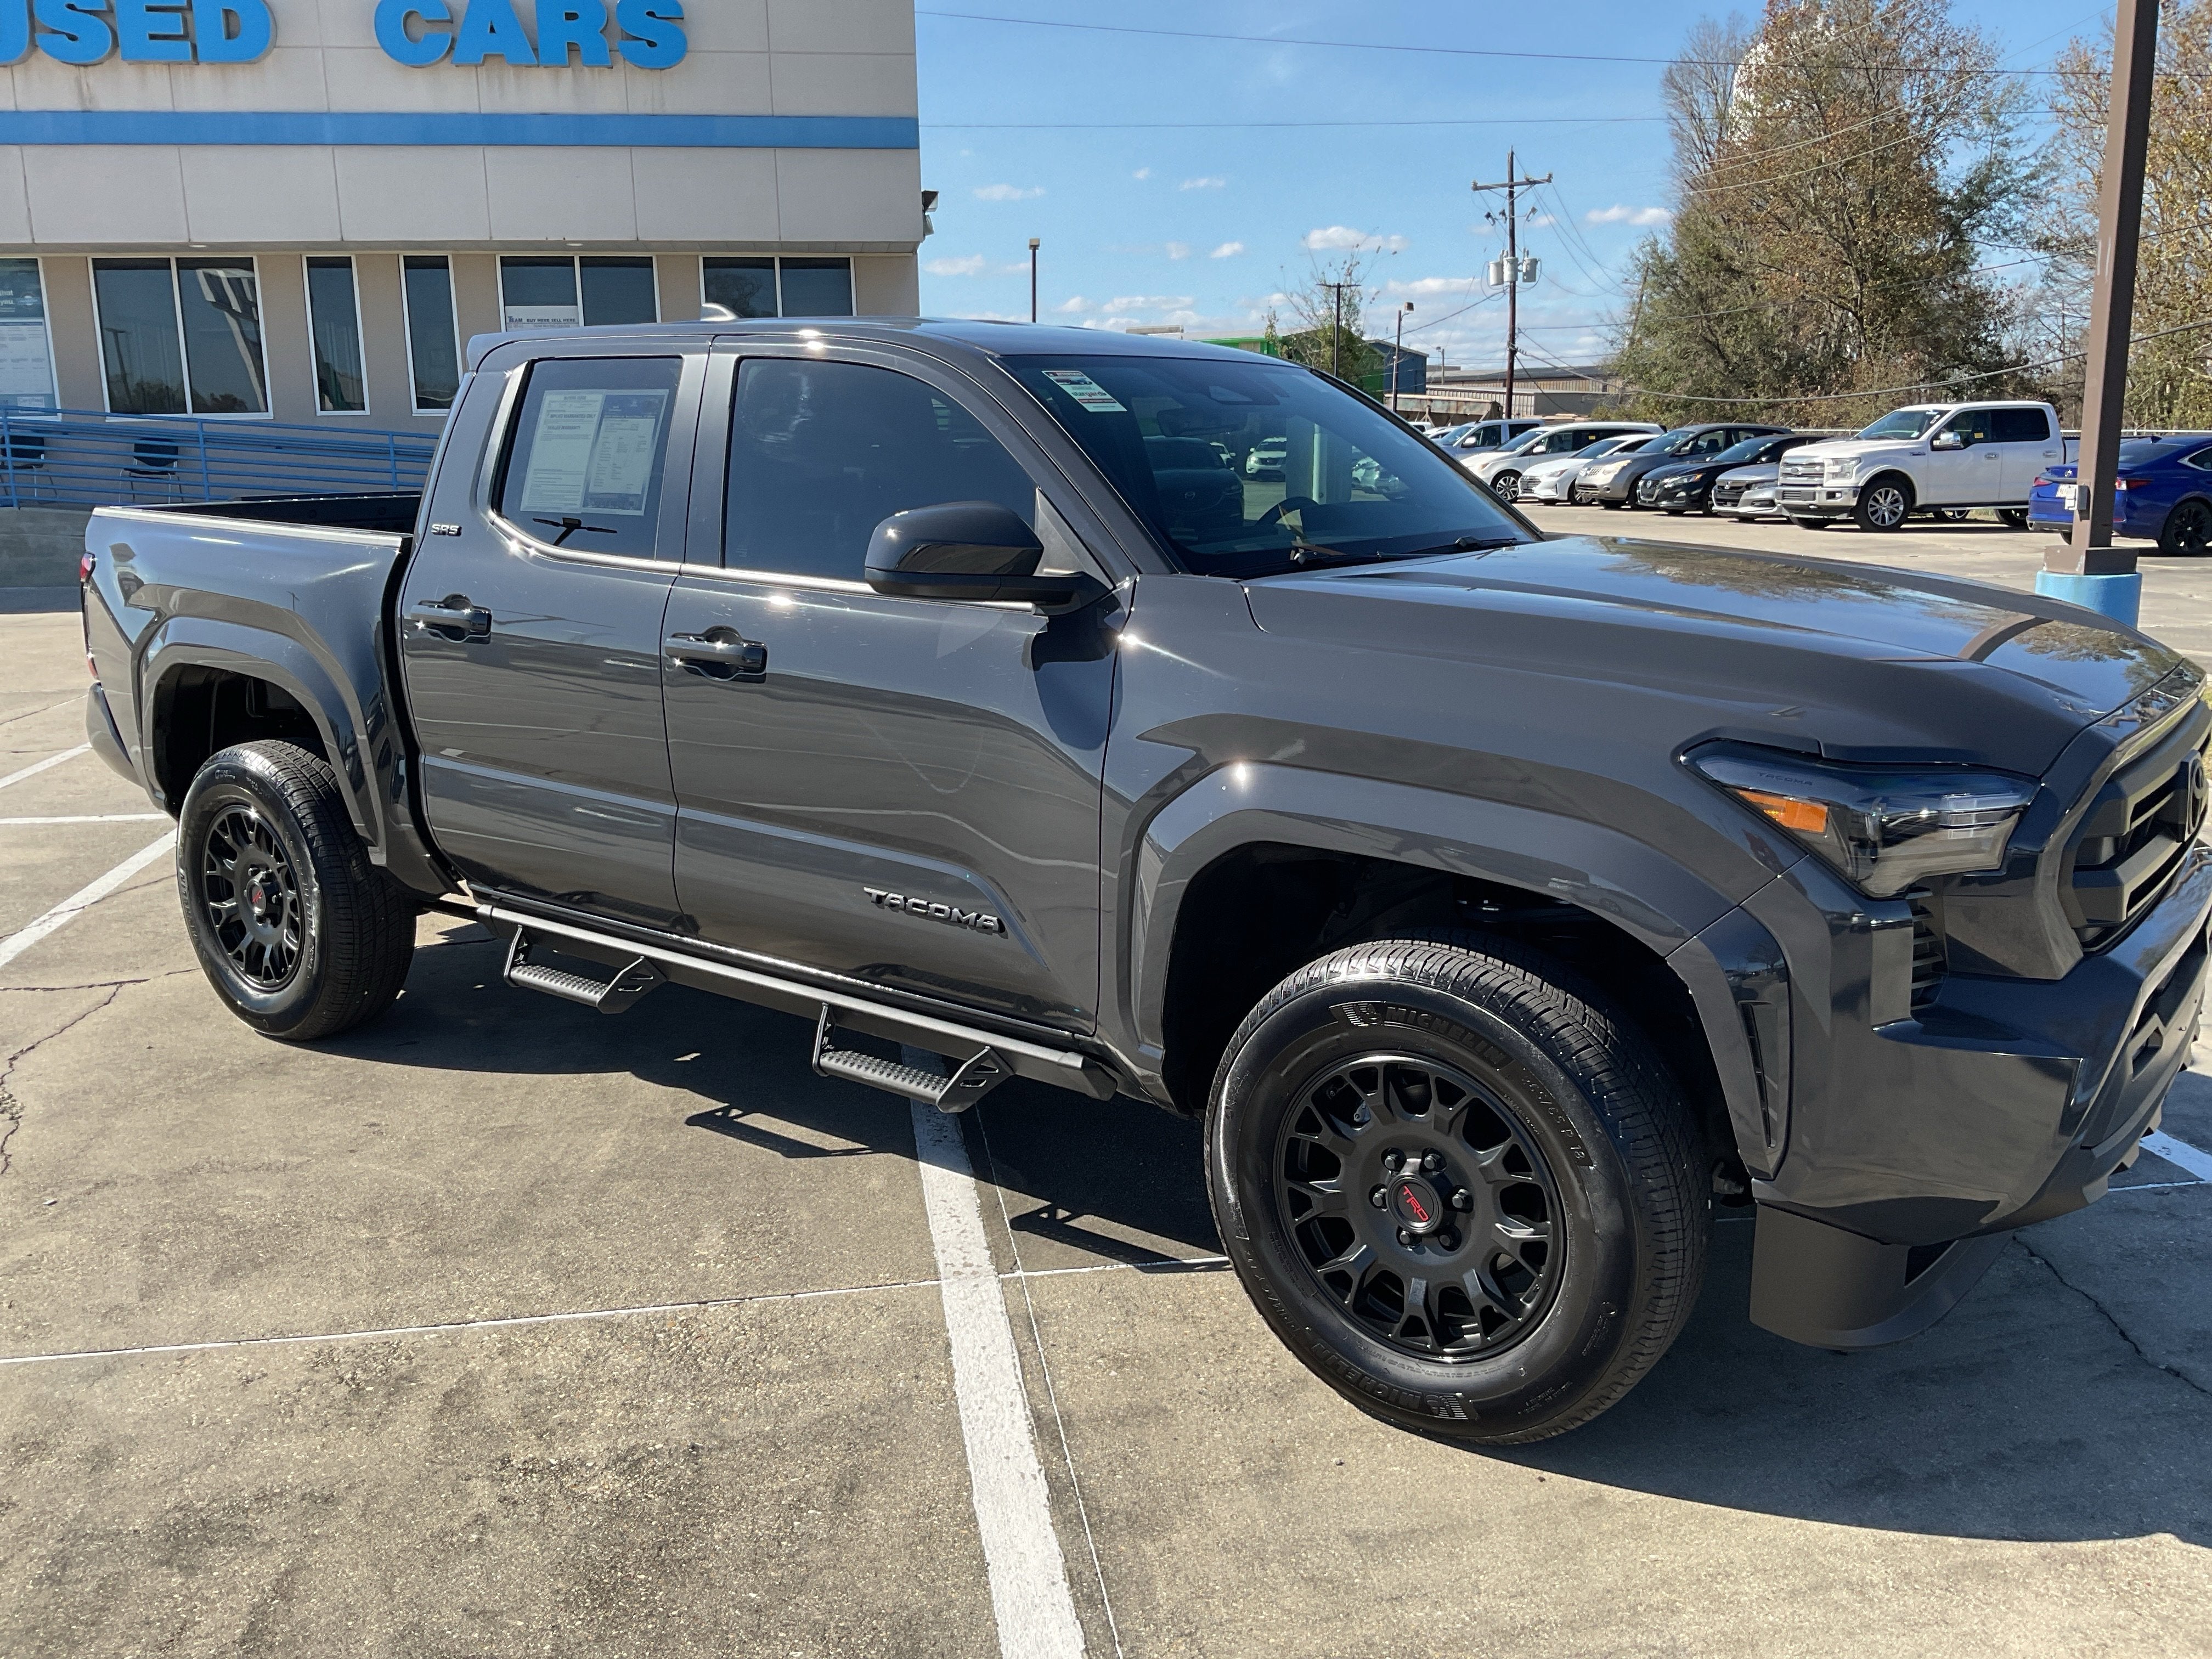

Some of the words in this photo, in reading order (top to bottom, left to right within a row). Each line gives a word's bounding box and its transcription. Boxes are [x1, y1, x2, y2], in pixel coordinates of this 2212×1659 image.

[374, 0, 688, 69] CARS
[431, 524, 461, 535] SR5
[1757, 771, 1813, 786] TACOMA
[863, 886, 1006, 935] TACOMA
[1386, 1006, 1508, 1065] MICHELIN
[1402, 1185, 1429, 1222] TRD
[1311, 1342, 1421, 1409] MICHELIN
